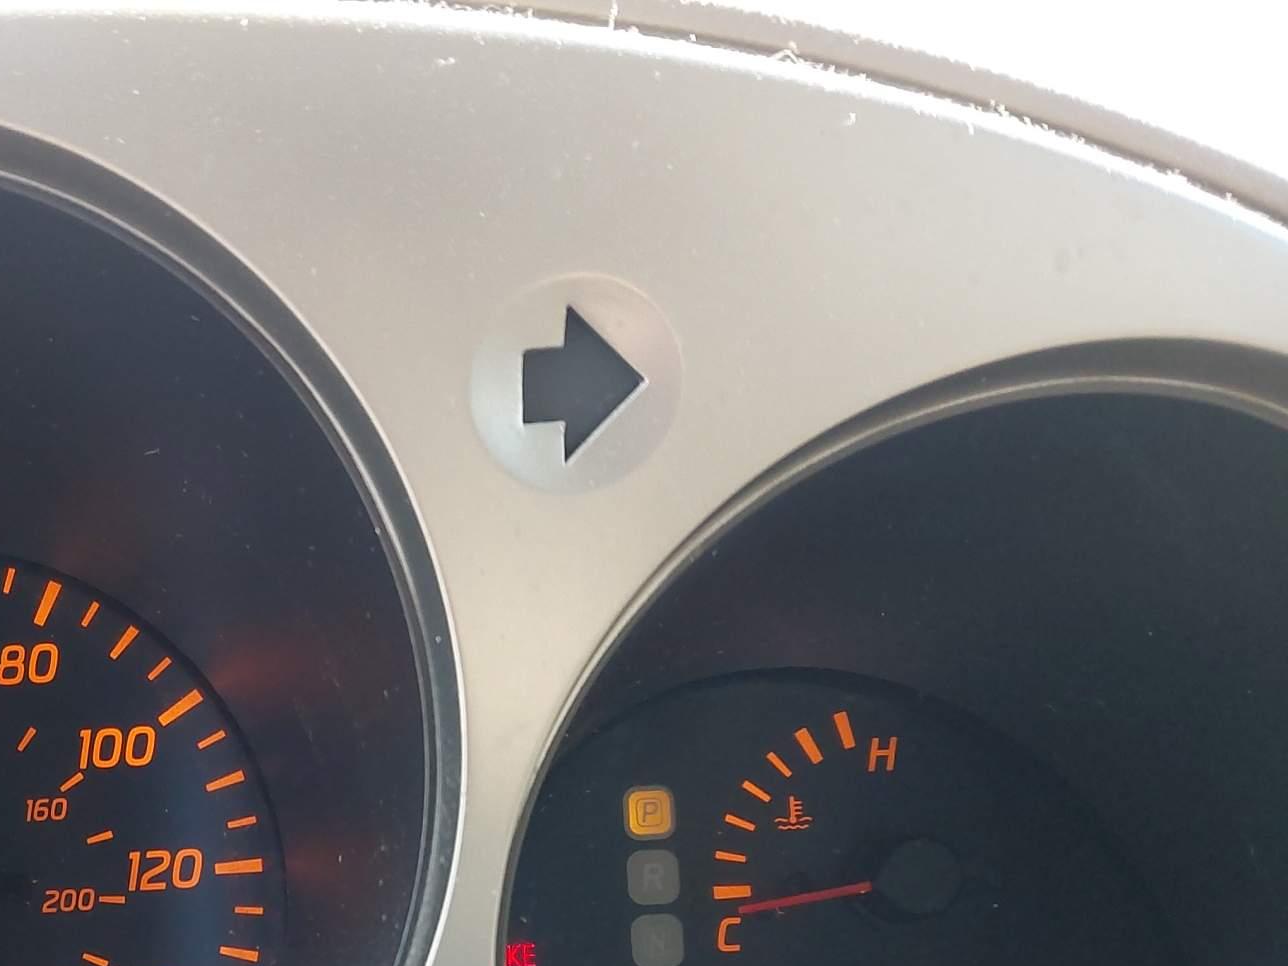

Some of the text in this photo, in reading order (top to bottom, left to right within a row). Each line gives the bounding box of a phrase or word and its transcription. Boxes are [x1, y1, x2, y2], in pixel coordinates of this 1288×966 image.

[78, 725, 157, 769] 100
[867, 737, 898, 771] H
[25, 798, 68, 822] 160
[642, 801, 660, 824] P
[128, 848, 203, 892] 120
[642, 863, 665, 892] R
[42, 887, 96, 913] 200
[716, 916, 741, 953] C
